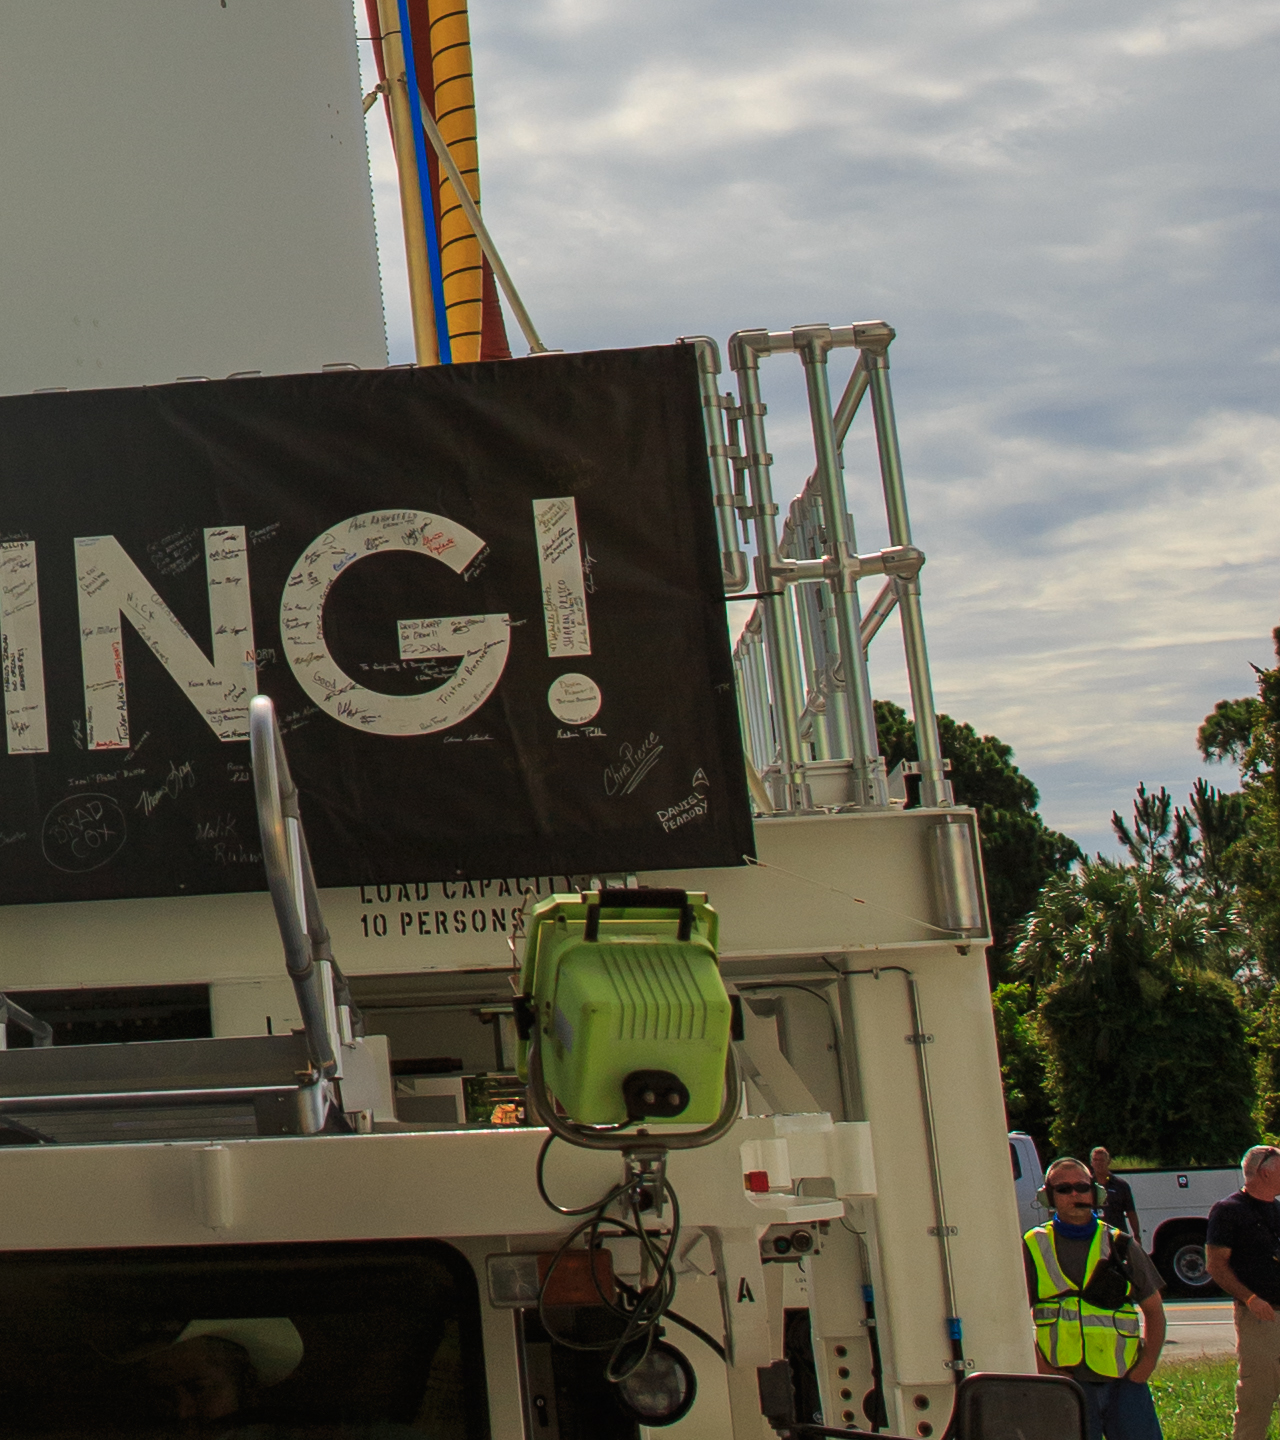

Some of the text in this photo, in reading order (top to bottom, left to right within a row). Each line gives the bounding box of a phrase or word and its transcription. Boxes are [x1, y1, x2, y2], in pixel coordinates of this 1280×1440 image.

[437, 677, 467, 705] Tristan
[603, 732, 660, 796] Chris Pierce
[48, 800, 104, 845] BRAD
[656, 791, 705, 823] DANIEL
[661, 800, 709, 833] PEABODY
[71, 823, 117, 858] COX
[359, 882, 429, 904] LOAD
[360, 907, 526, 938] 10 PERSONS
[737, 1277, 755, 1303] A
